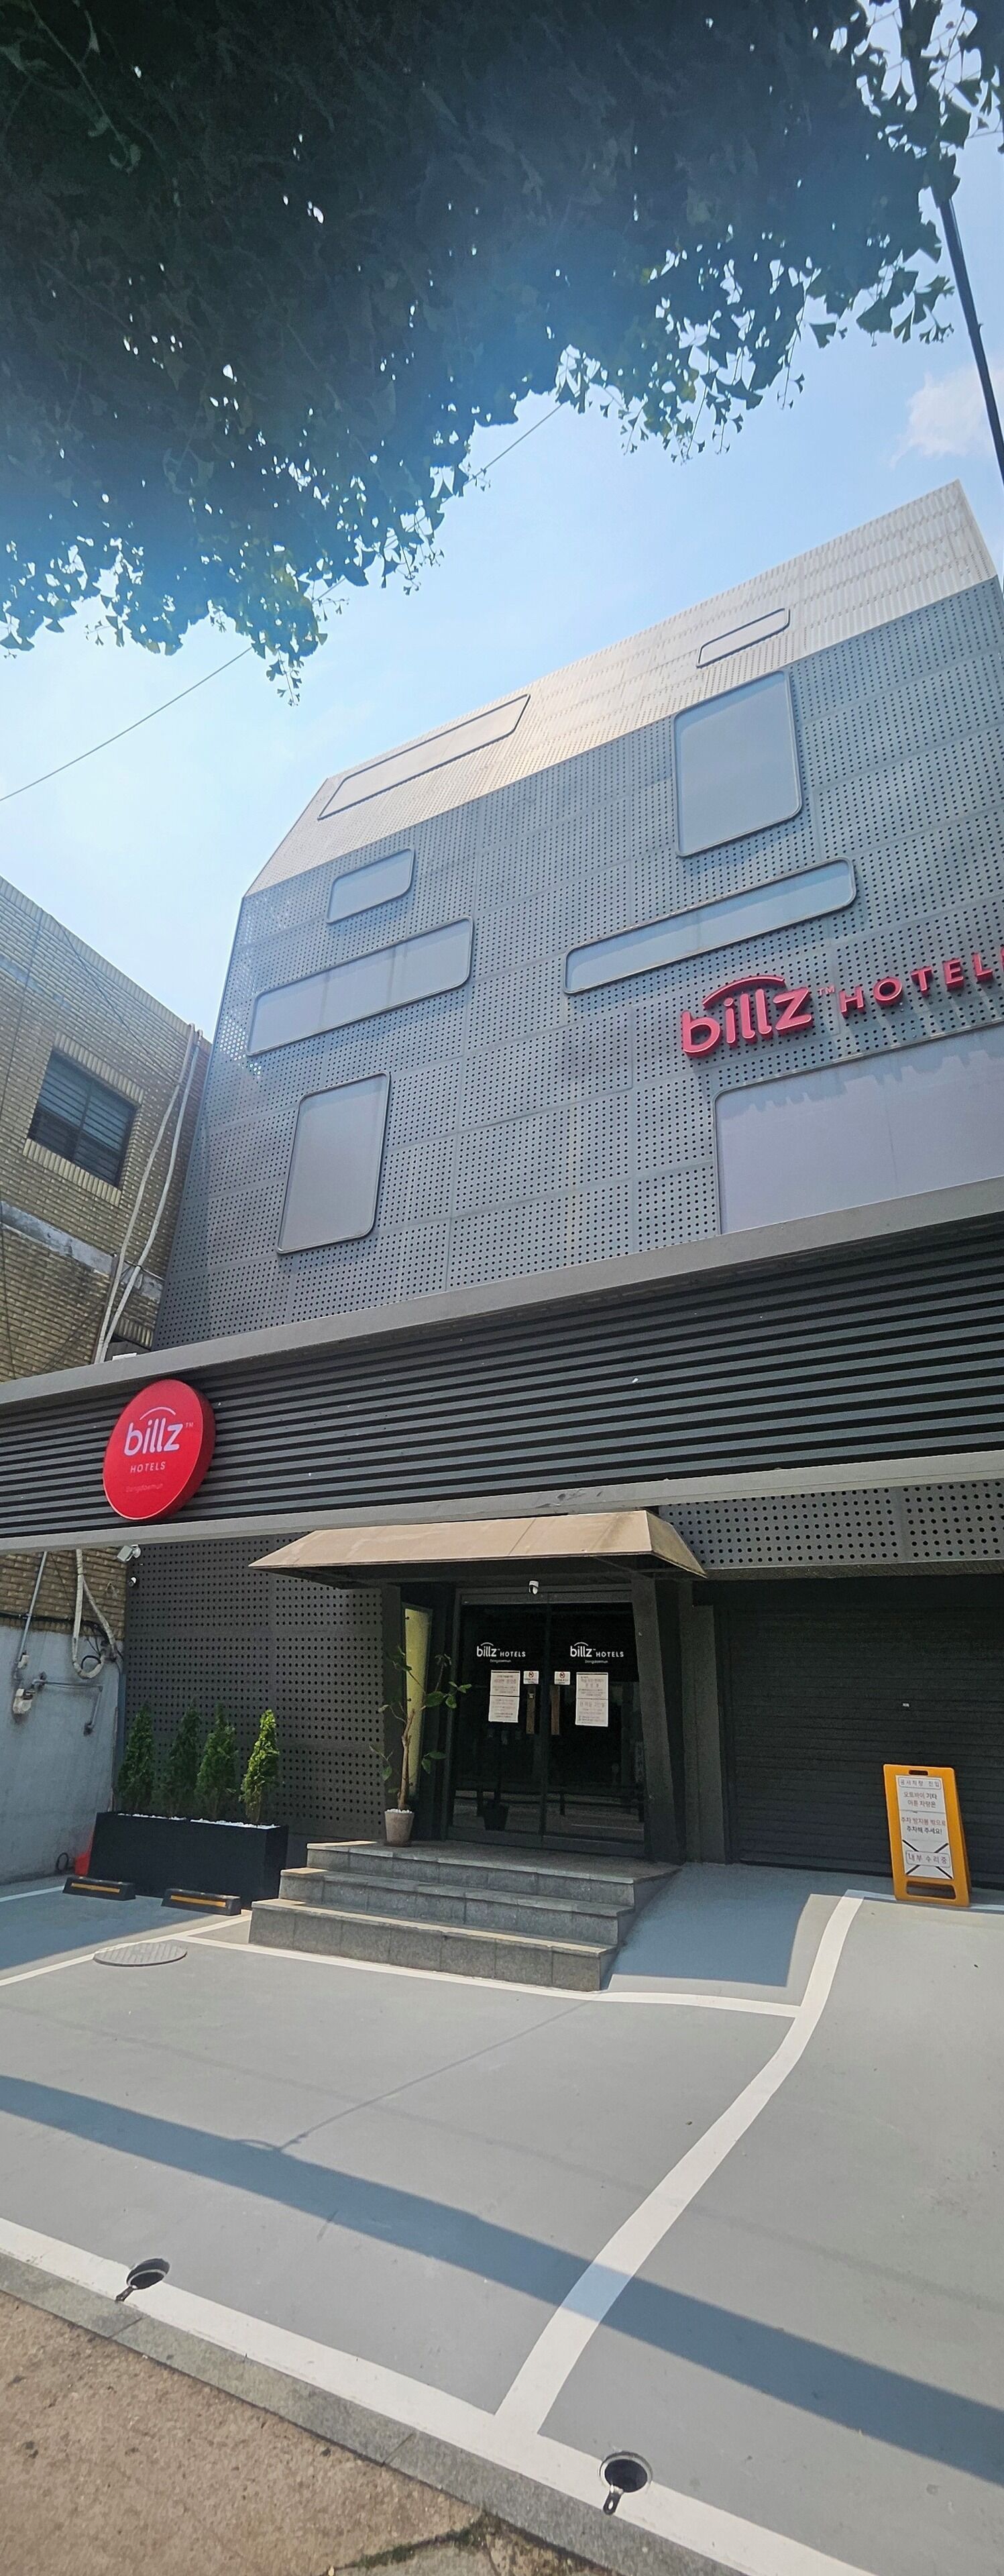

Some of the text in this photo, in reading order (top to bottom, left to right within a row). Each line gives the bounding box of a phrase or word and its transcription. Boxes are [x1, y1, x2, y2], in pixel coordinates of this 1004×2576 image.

[681, 986, 813, 1059] billz
[839, 947, 1004, 1018] HOTEL
[124, 1417, 184, 1456] billz
[130, 1461, 166, 1473] HOTELS
[476, 1646, 498, 1658] billz
[569, 1646, 593, 1658] billz
[906, 1825, 924, 1833] 주차해
[907, 1852, 922, 1862] 내부
